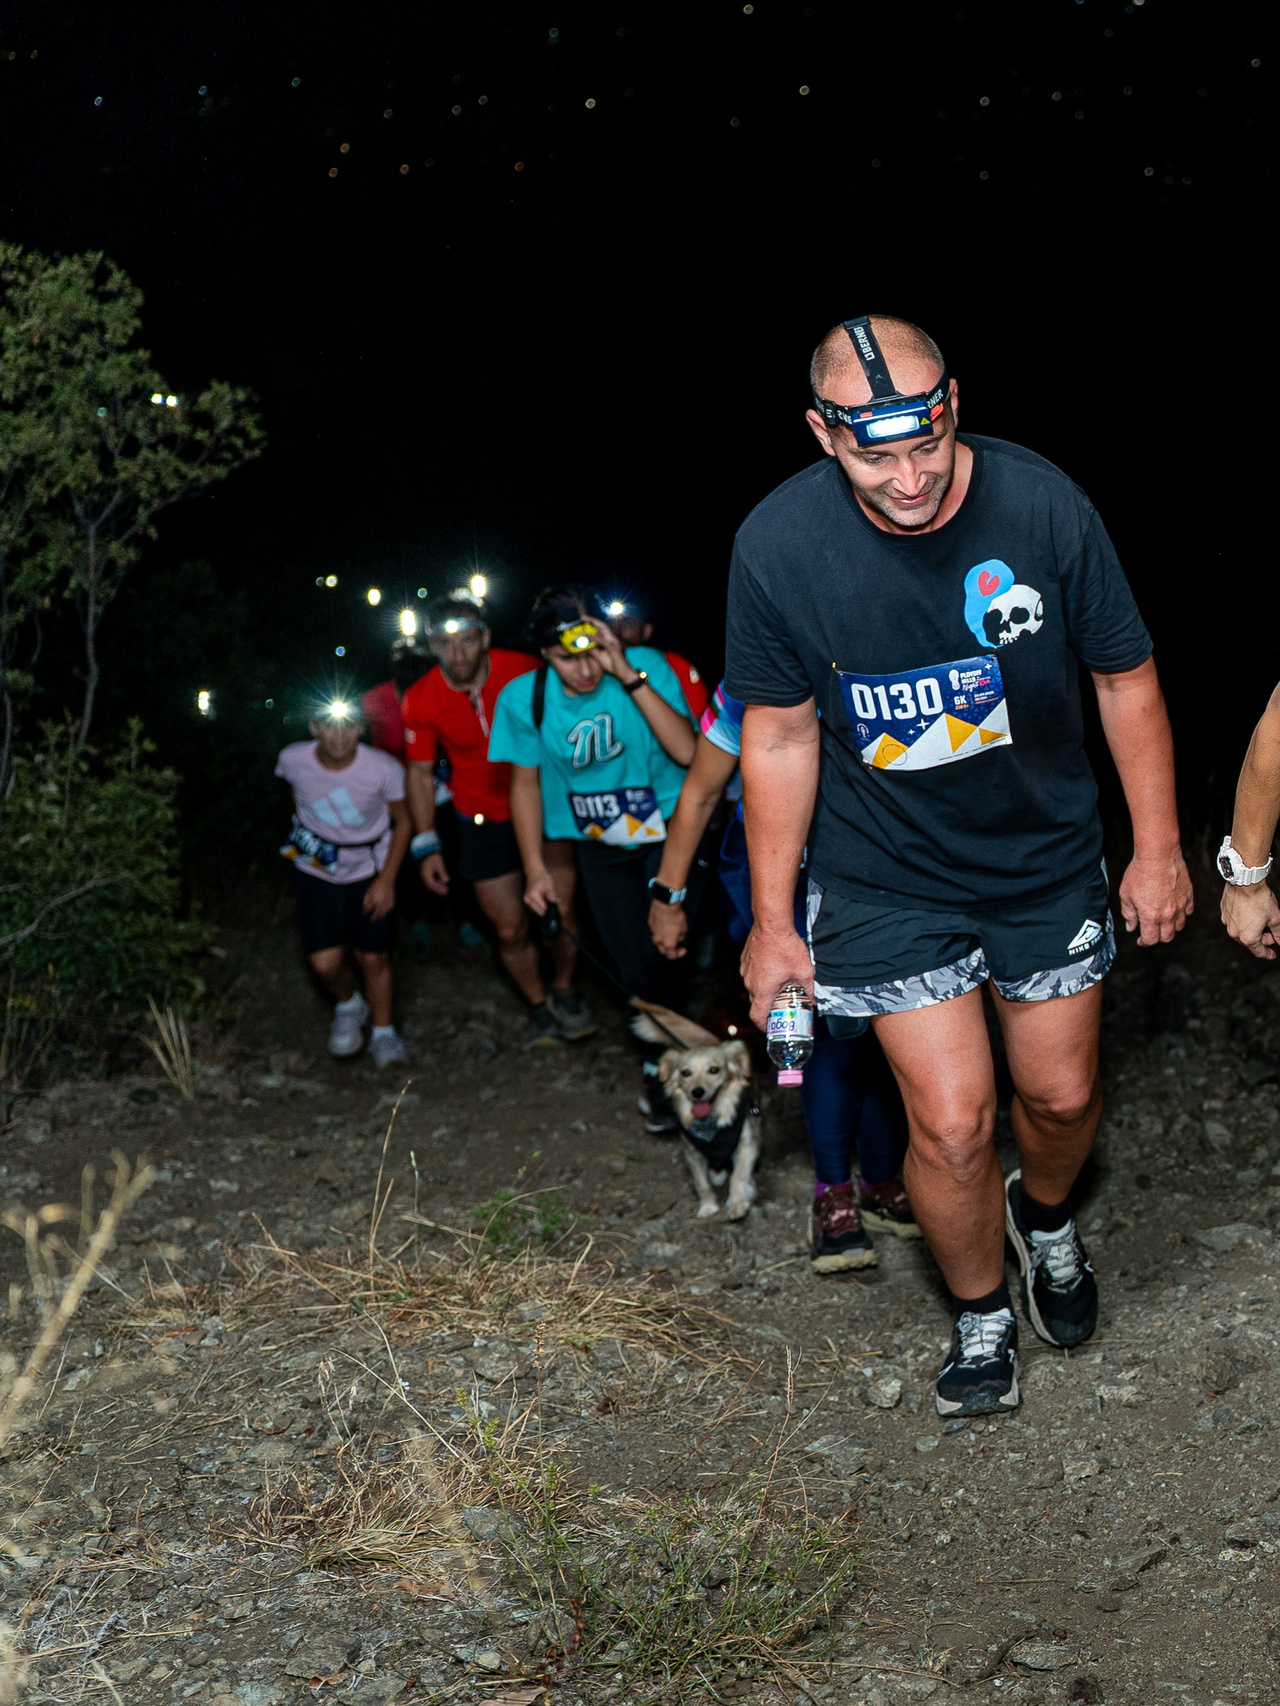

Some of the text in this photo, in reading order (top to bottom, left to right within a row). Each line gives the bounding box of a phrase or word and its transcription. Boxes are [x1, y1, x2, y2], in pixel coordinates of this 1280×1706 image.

[850, 677, 944, 721] 0130
[953, 694, 967, 706] 6K
[572, 794, 621, 819] 0113
